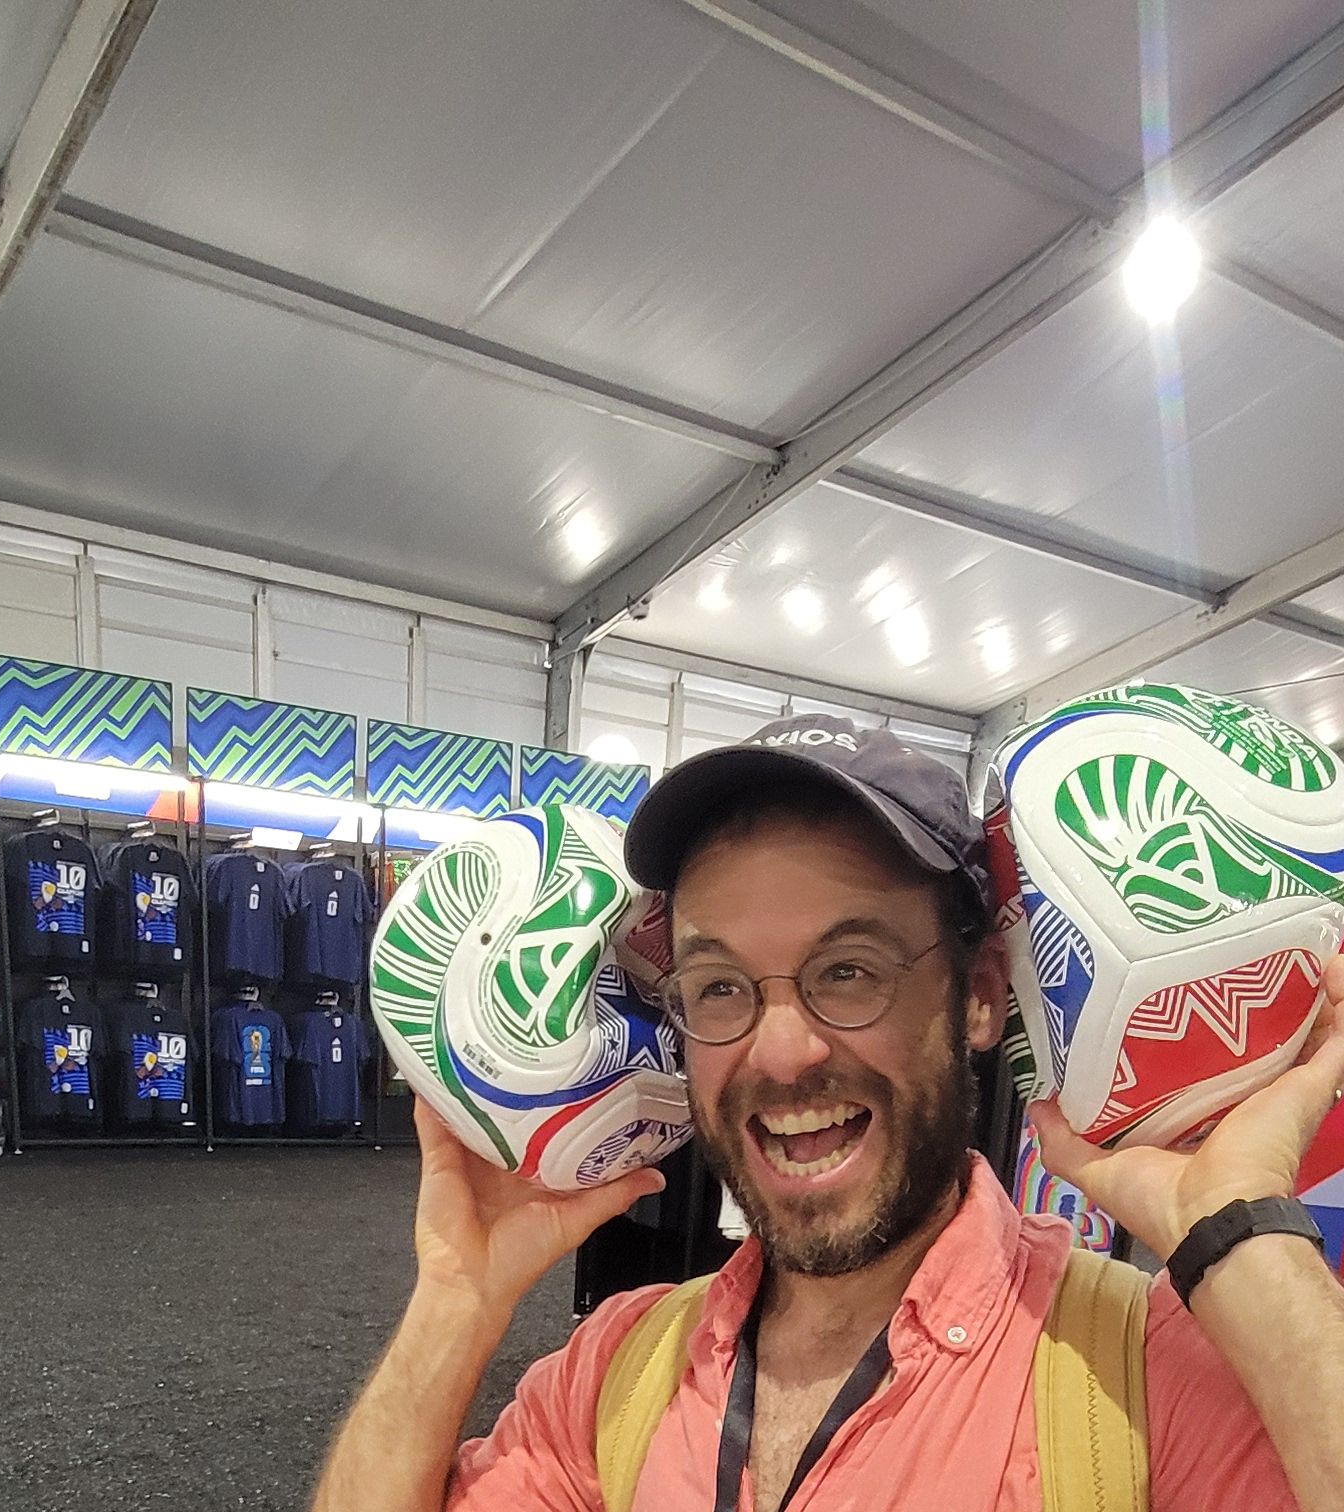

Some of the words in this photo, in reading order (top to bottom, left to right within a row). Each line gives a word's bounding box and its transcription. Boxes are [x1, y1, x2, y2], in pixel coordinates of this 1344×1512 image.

[750, 729, 859, 752] XIOS
[57, 864, 86, 890] 10
[152, 875, 180, 901] 10
[67, 1027, 92, 1051] 10
[158, 1035, 187, 1059] 10
